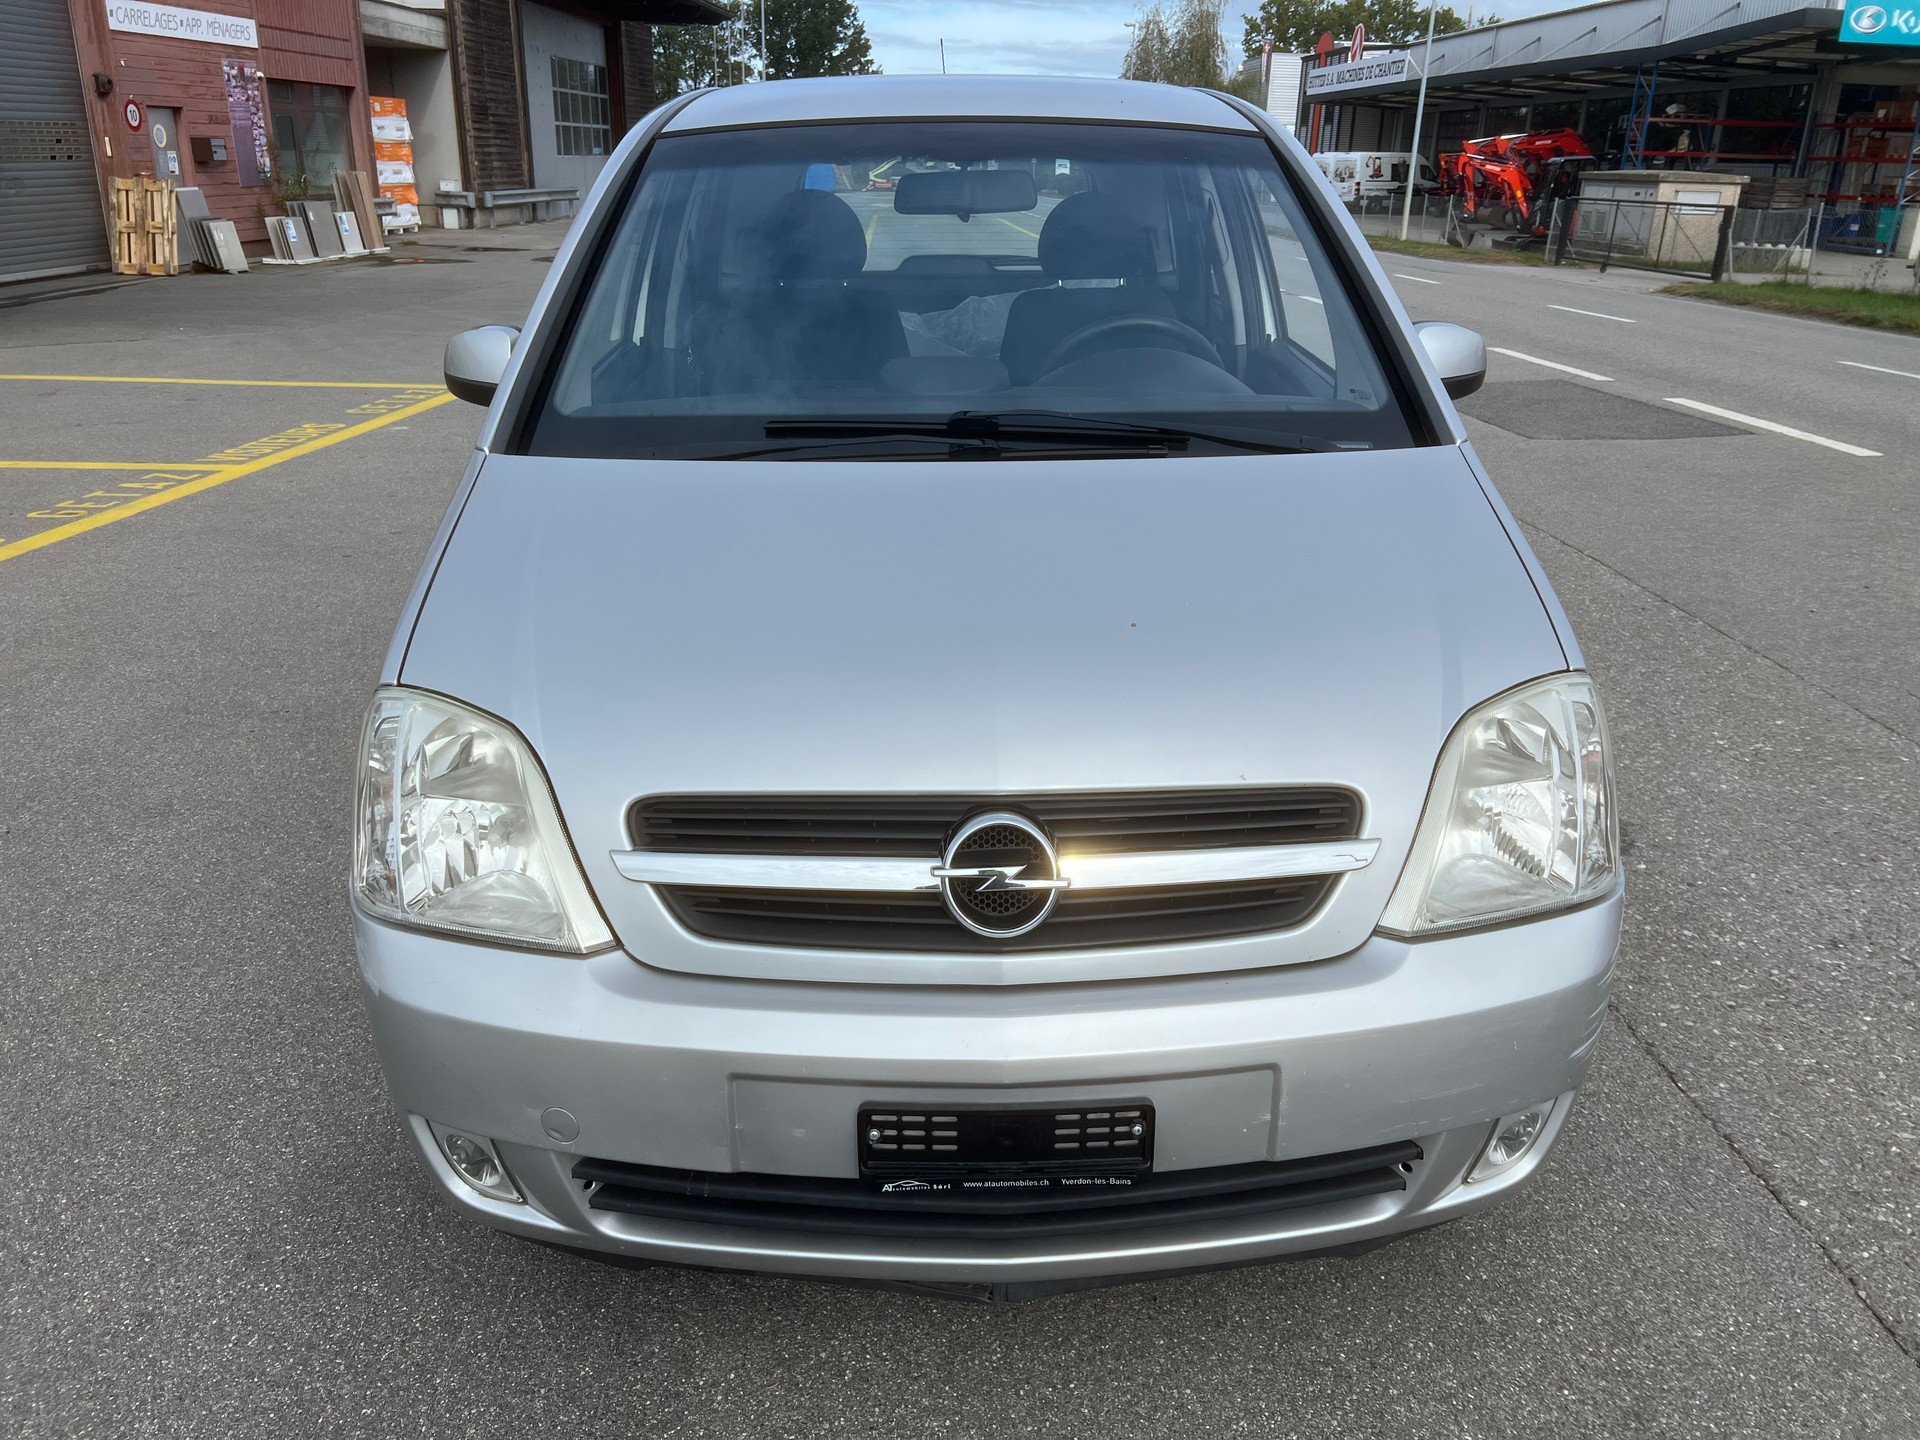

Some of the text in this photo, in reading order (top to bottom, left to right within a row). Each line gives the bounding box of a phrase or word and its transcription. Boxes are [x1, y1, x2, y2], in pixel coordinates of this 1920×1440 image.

[115, 6, 251, 41] CARRELAGES APP. MÉNAGERS
[1336, 66, 1365, 84] MACHINES
[1365, 64, 1374, 80] DE
[1374, 59, 1406, 79] CHANTIER
[129, 109, 138, 122] 10
[194, 422, 347, 462] VISITEURS
[26, 472, 203, 519] GETAZ
[962, 1179, 1050, 1188] www.atautomobiles.ch
[1061, 1177, 1132, 1186] Yverdon-les-Bains
